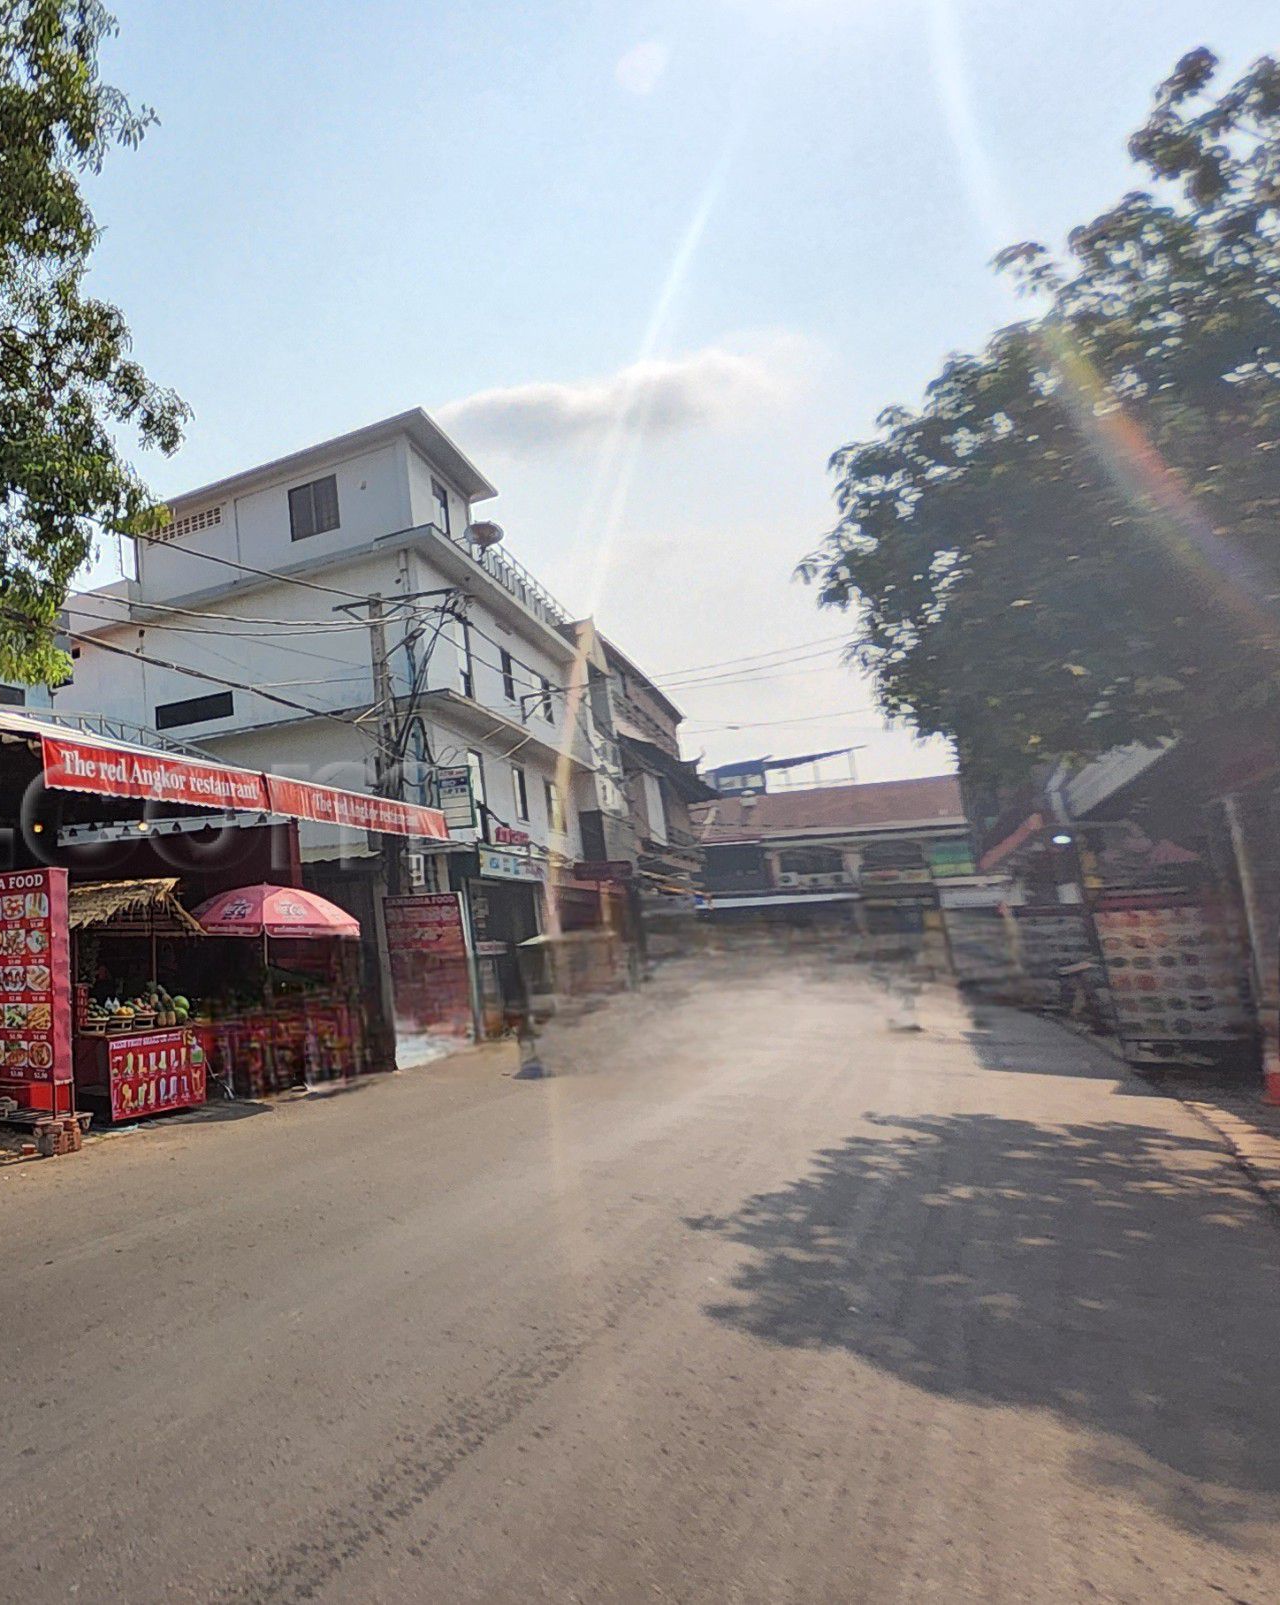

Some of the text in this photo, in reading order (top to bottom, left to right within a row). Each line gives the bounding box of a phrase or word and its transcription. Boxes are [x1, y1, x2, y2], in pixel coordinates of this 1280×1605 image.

[61, 749, 96, 777] The
[100, 759, 127, 781] red
[131, 758, 186, 793] Angkor
[314, 793, 332, 813] The
[9, 874, 43, 889] FOOD
